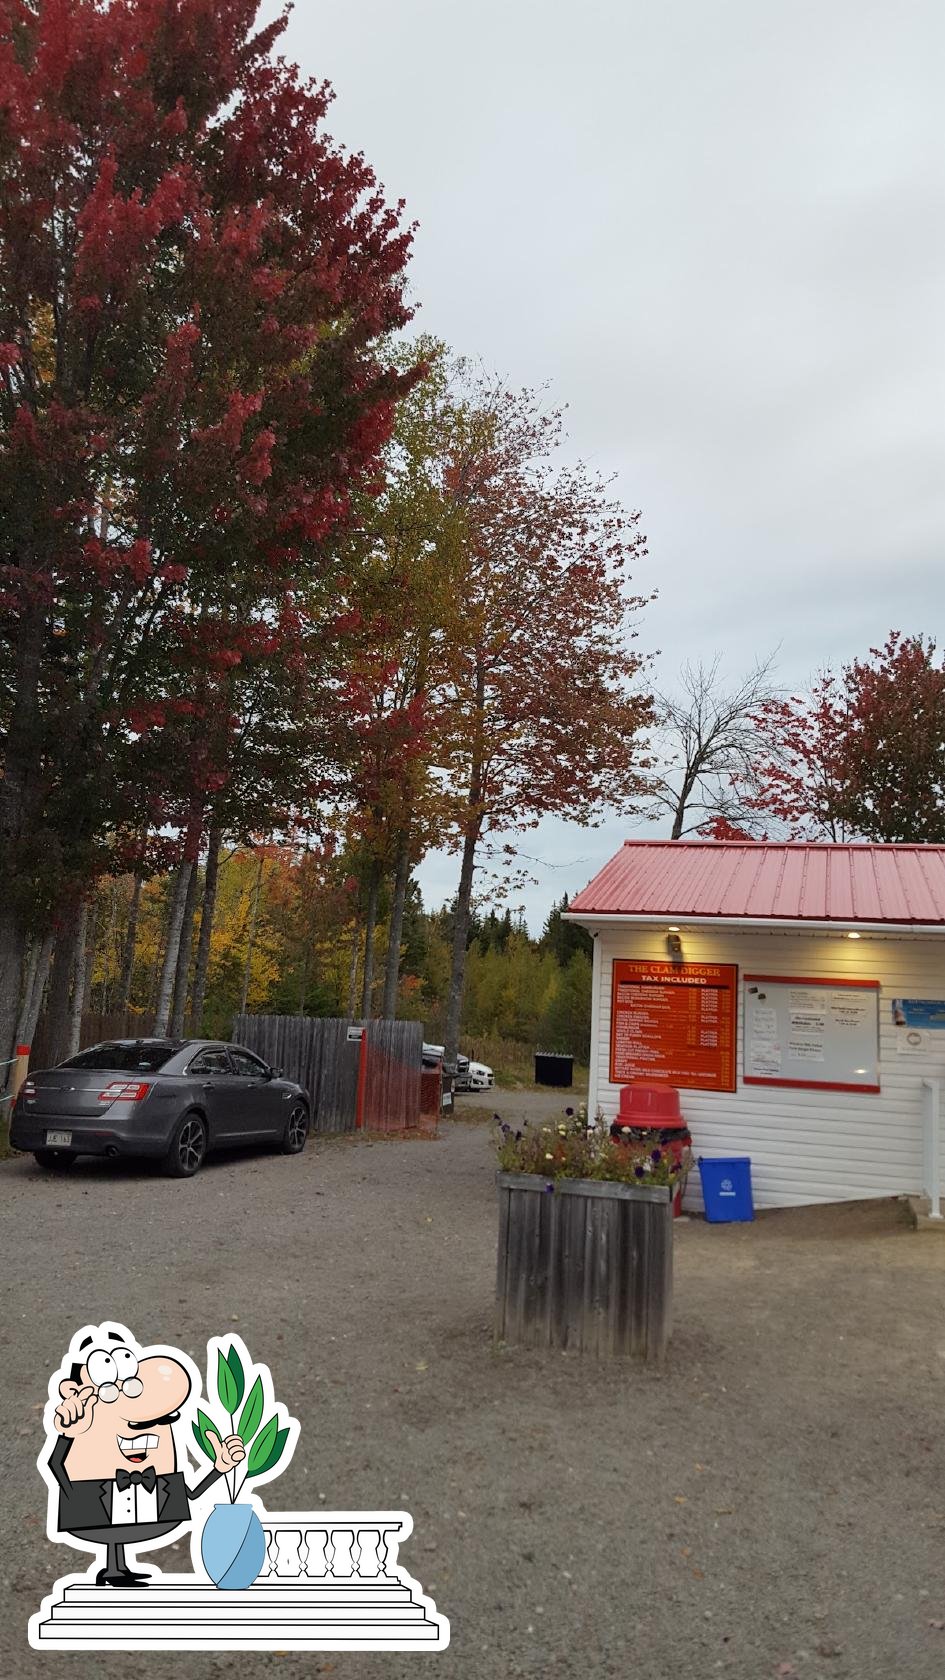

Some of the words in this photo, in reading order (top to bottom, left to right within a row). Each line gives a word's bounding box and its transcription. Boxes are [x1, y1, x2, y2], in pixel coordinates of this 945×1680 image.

[629, 965, 649, 973] THE
[650, 966, 678, 974] CLAM
[681, 967, 720, 976] DIGGER
[661, 976, 707, 984] INCLUDED
